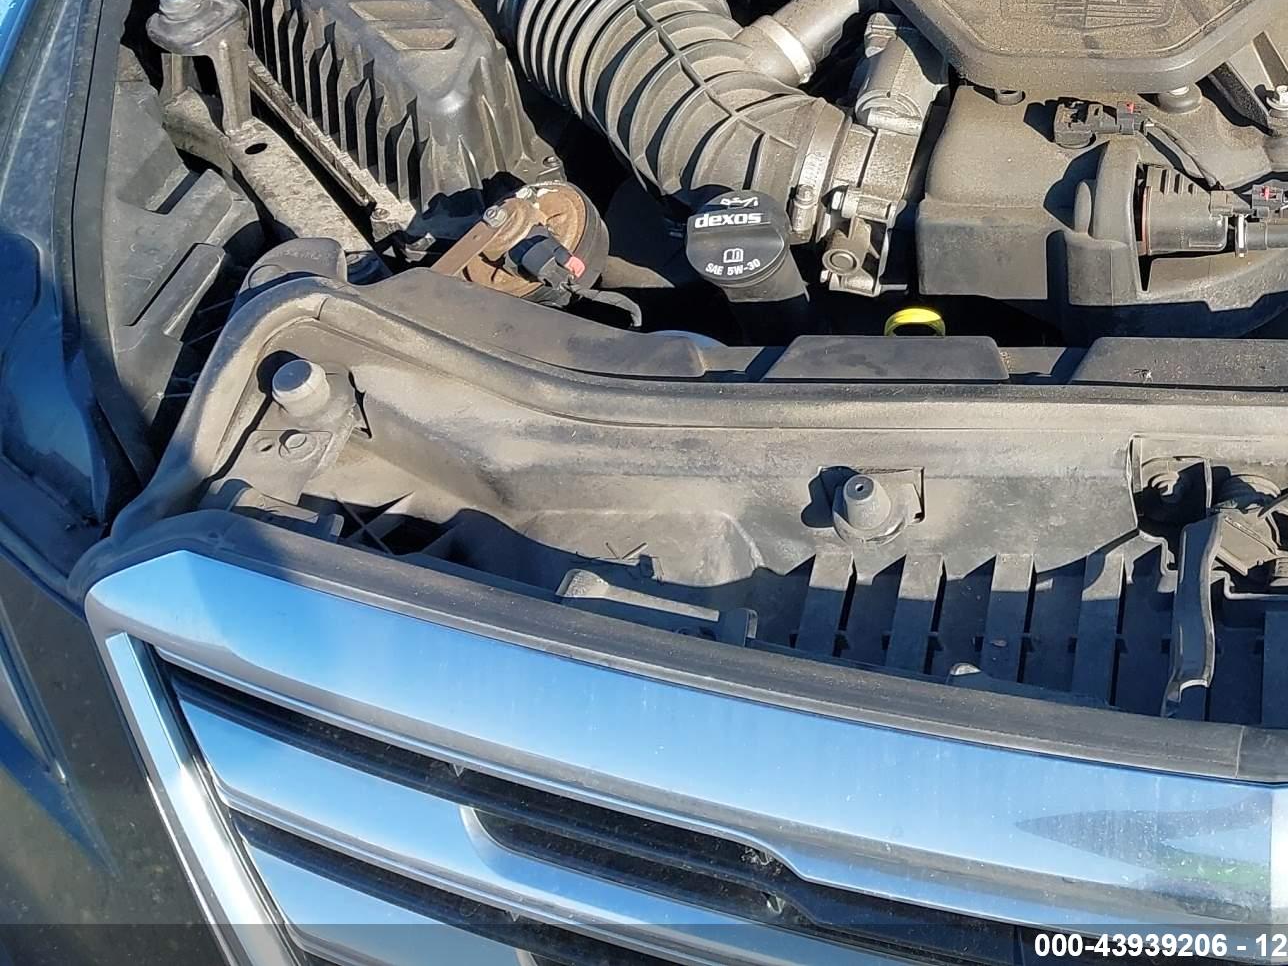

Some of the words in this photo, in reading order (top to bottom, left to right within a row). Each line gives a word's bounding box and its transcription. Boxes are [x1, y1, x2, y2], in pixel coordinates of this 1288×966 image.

[694, 213, 765, 228] dexos
[705, 262, 725, 276] SAE
[727, 258, 761, 276] 5W-30
